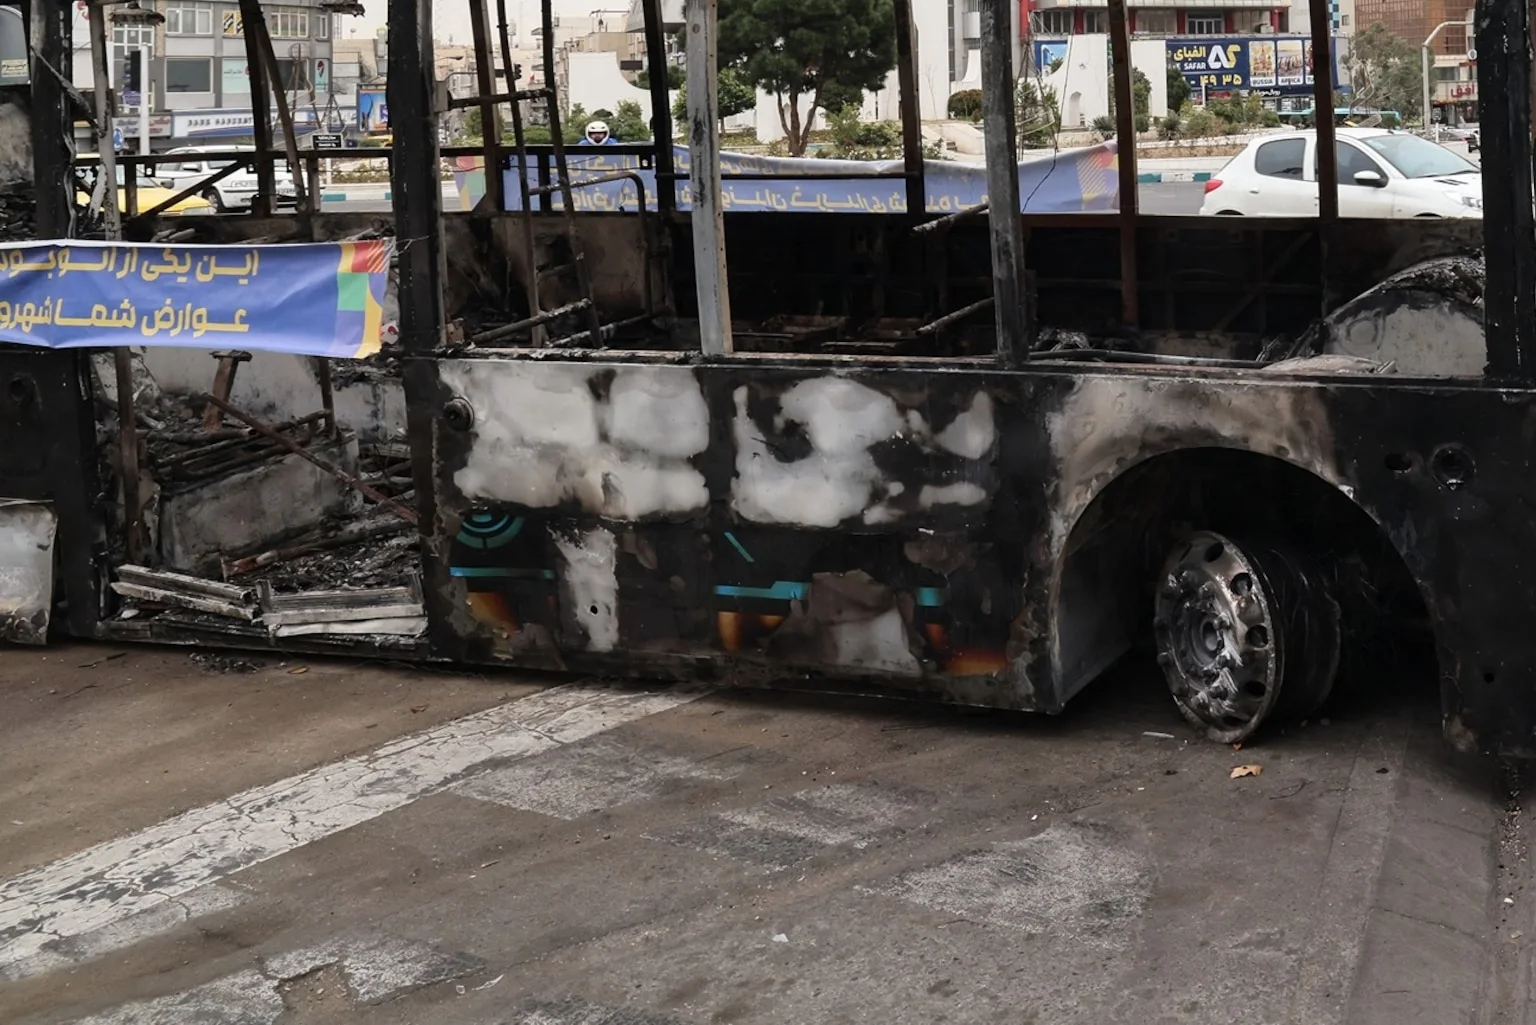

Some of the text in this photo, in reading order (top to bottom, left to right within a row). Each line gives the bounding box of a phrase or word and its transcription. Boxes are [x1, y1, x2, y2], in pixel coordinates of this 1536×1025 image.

[1173, 46, 1206, 61] الفبای
[1183, 62, 1206, 70] SAFAR
[141, 247, 191, 284] یکی
[196, 249, 260, 286] این
[54, 297, 137, 329] شما
[140, 298, 251, 338] عوارض
